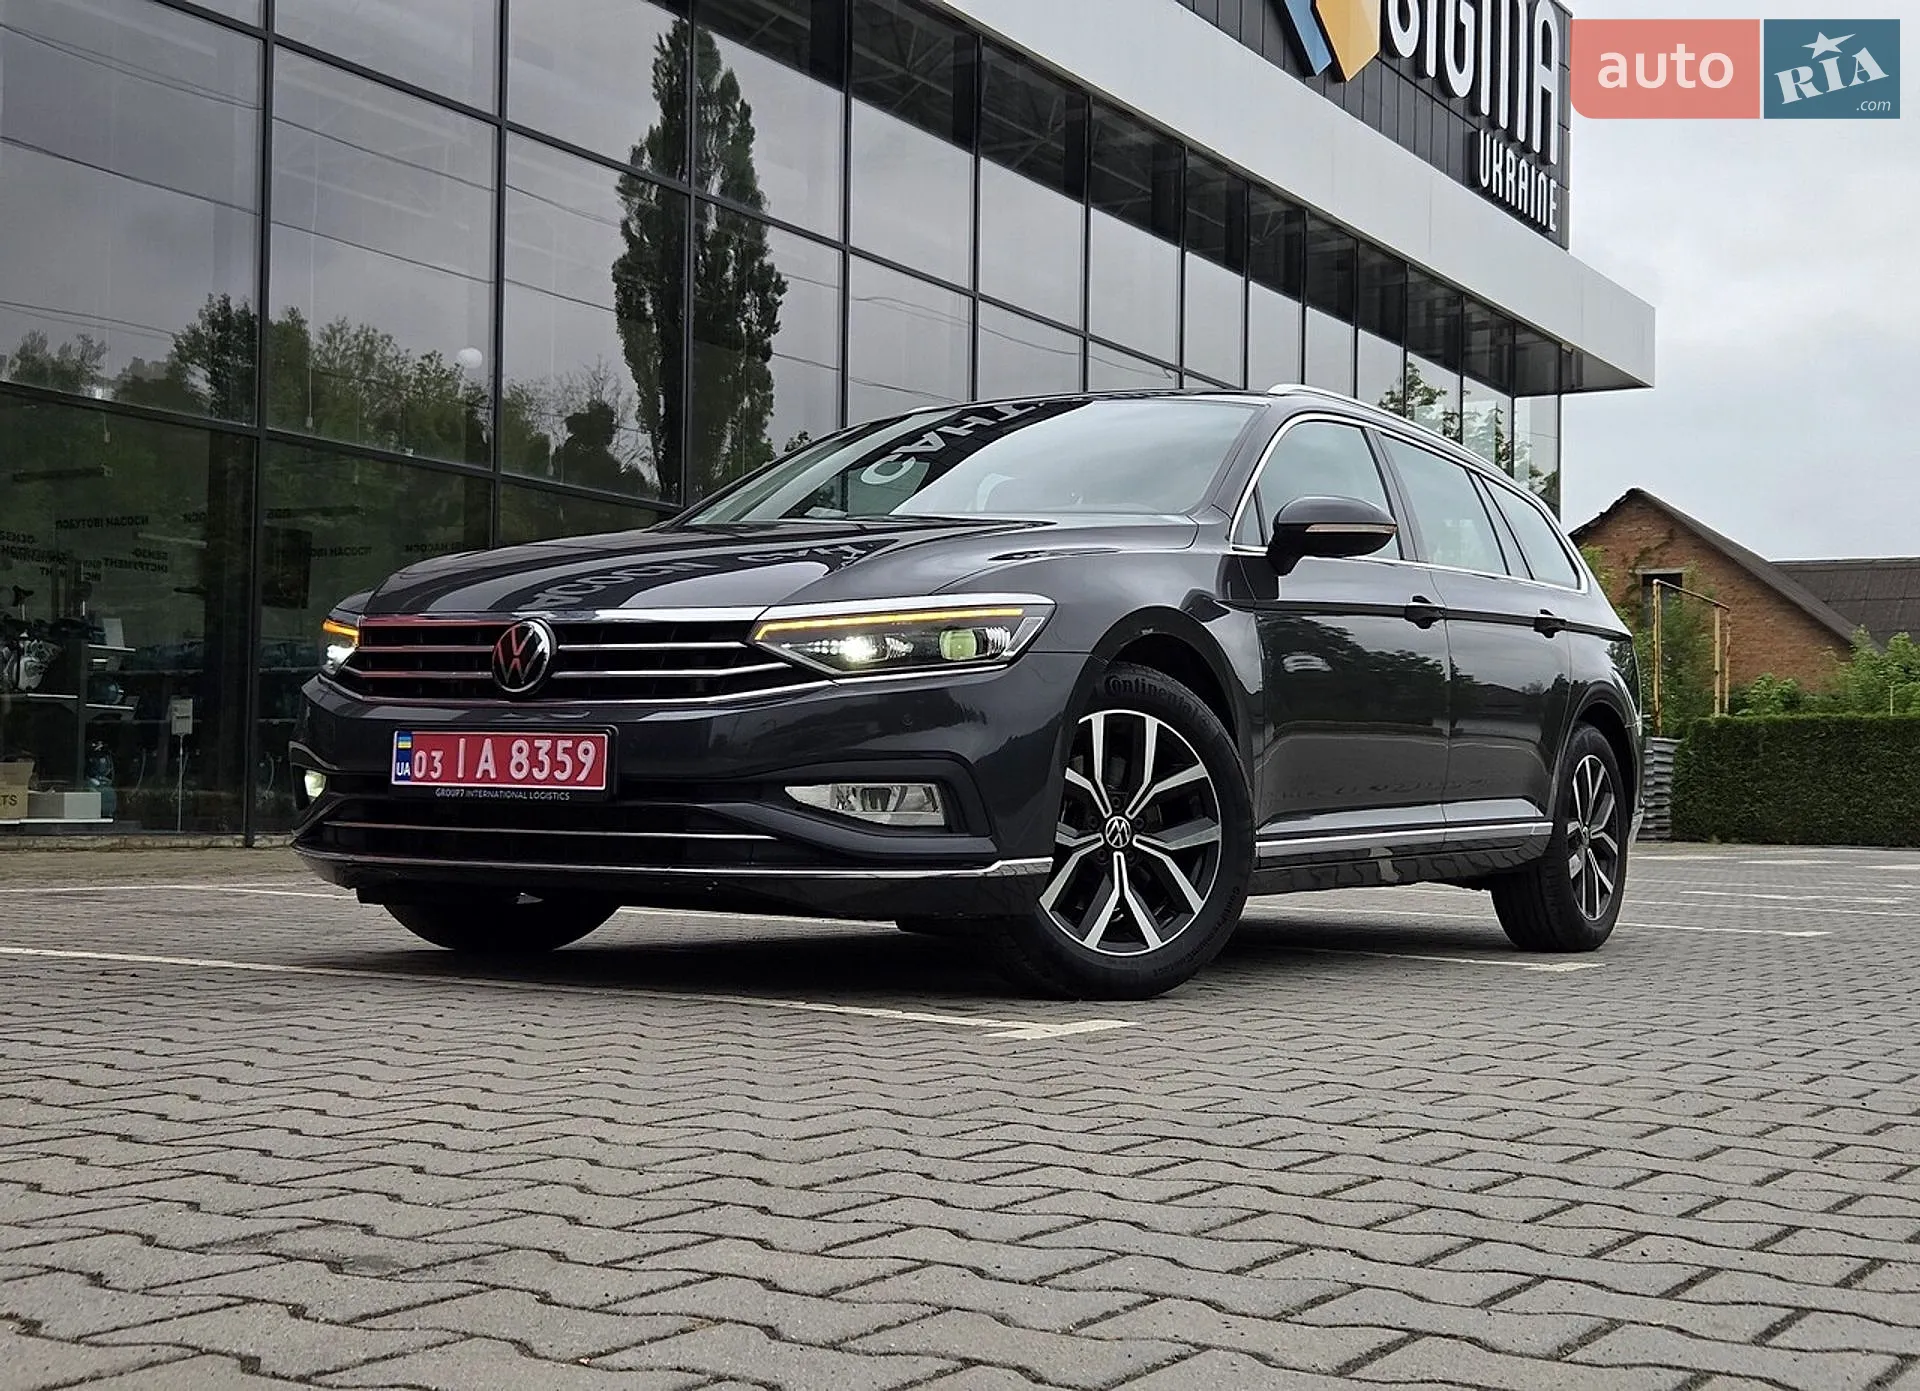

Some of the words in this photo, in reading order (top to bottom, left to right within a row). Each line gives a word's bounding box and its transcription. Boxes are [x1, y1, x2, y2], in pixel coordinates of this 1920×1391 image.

[1478, 128, 1557, 232] UKRAINE
[396, 761, 411, 777] UA
[414, 750, 443, 780] 03
[457, 738, 497, 780] IA
[509, 739, 597, 782] 8359
[466, 788, 528, 800] INTERNATIONAL
[529, 791, 571, 801] LOGISTICS
